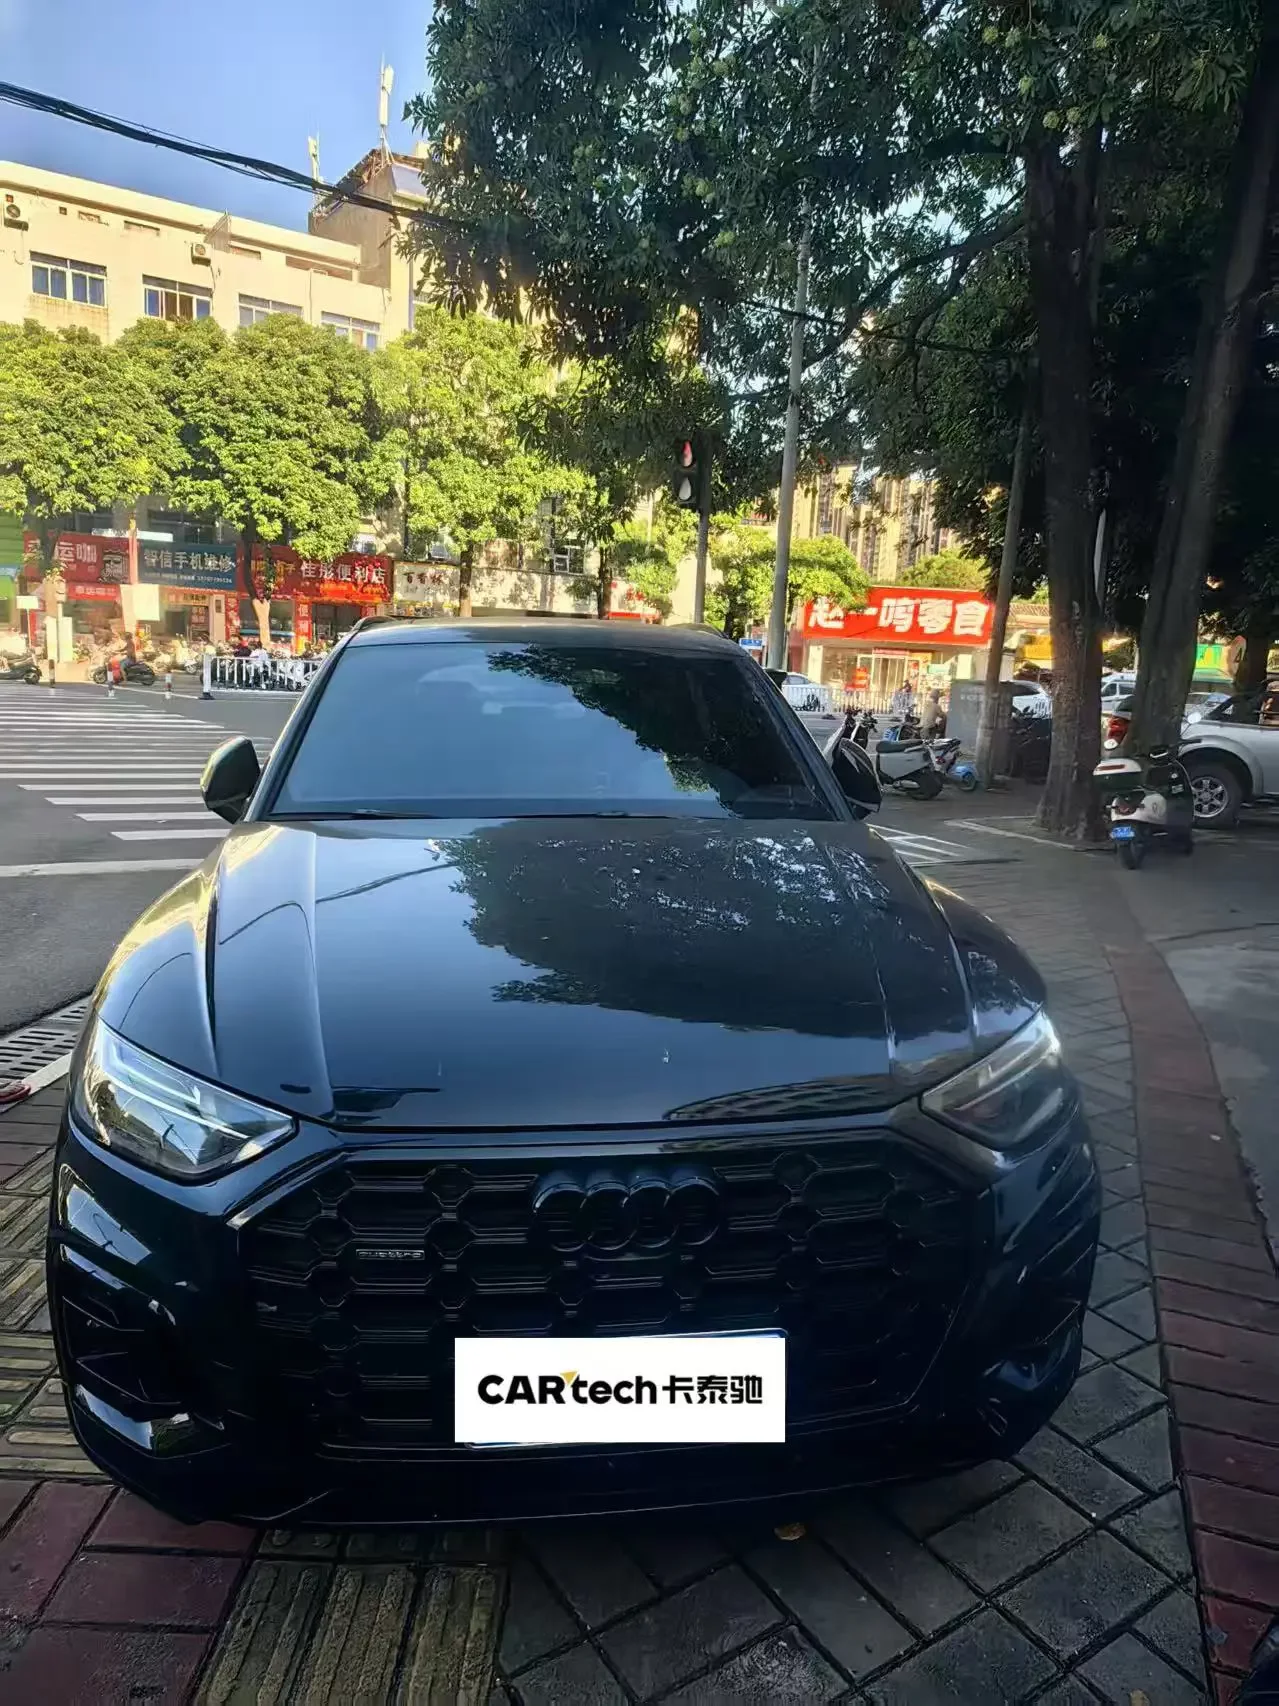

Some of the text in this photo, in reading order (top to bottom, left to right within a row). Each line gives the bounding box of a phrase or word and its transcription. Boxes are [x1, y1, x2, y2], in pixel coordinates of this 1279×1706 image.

[143, 549, 236, 573] 智信手机维修
